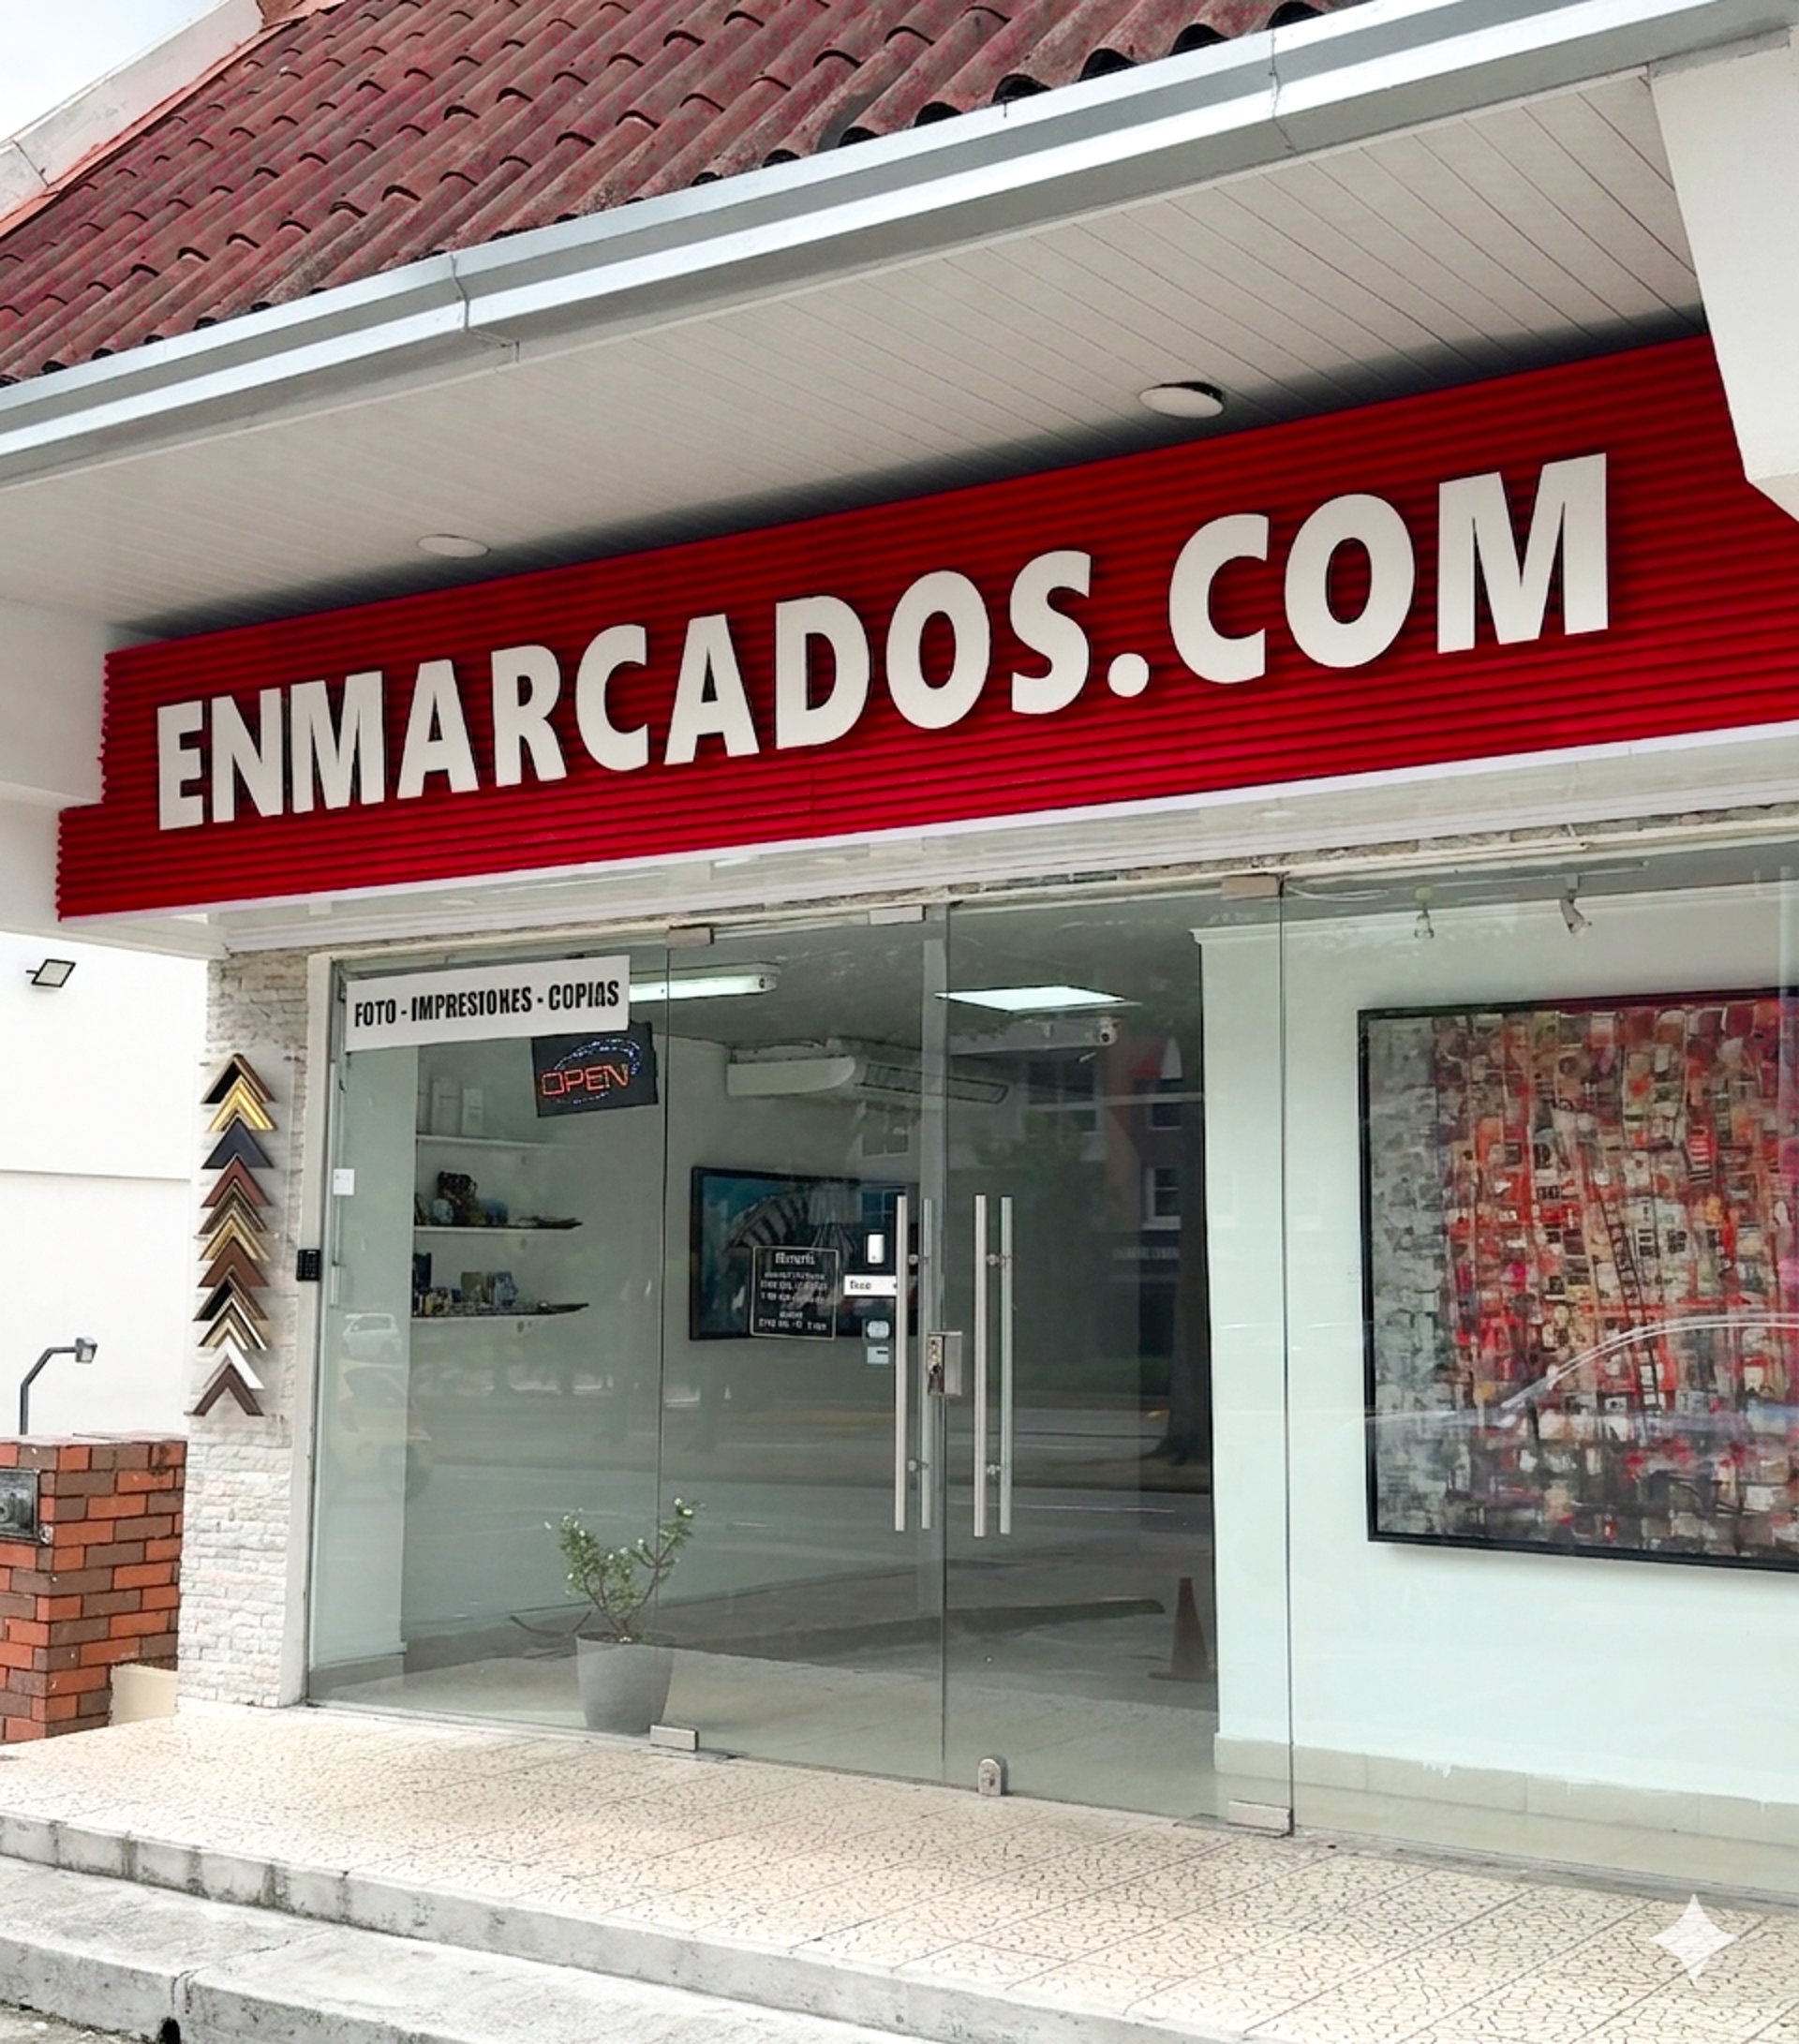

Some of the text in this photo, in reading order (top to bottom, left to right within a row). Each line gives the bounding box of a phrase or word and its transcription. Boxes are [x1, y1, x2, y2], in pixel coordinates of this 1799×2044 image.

[156, 452, 1611, 831] ENMARCADOS.COM
[354, 998, 396, 1028] FOTO
[548, 980, 619, 1011] COPIAS
[541, 1062, 630, 1096] OPEN
